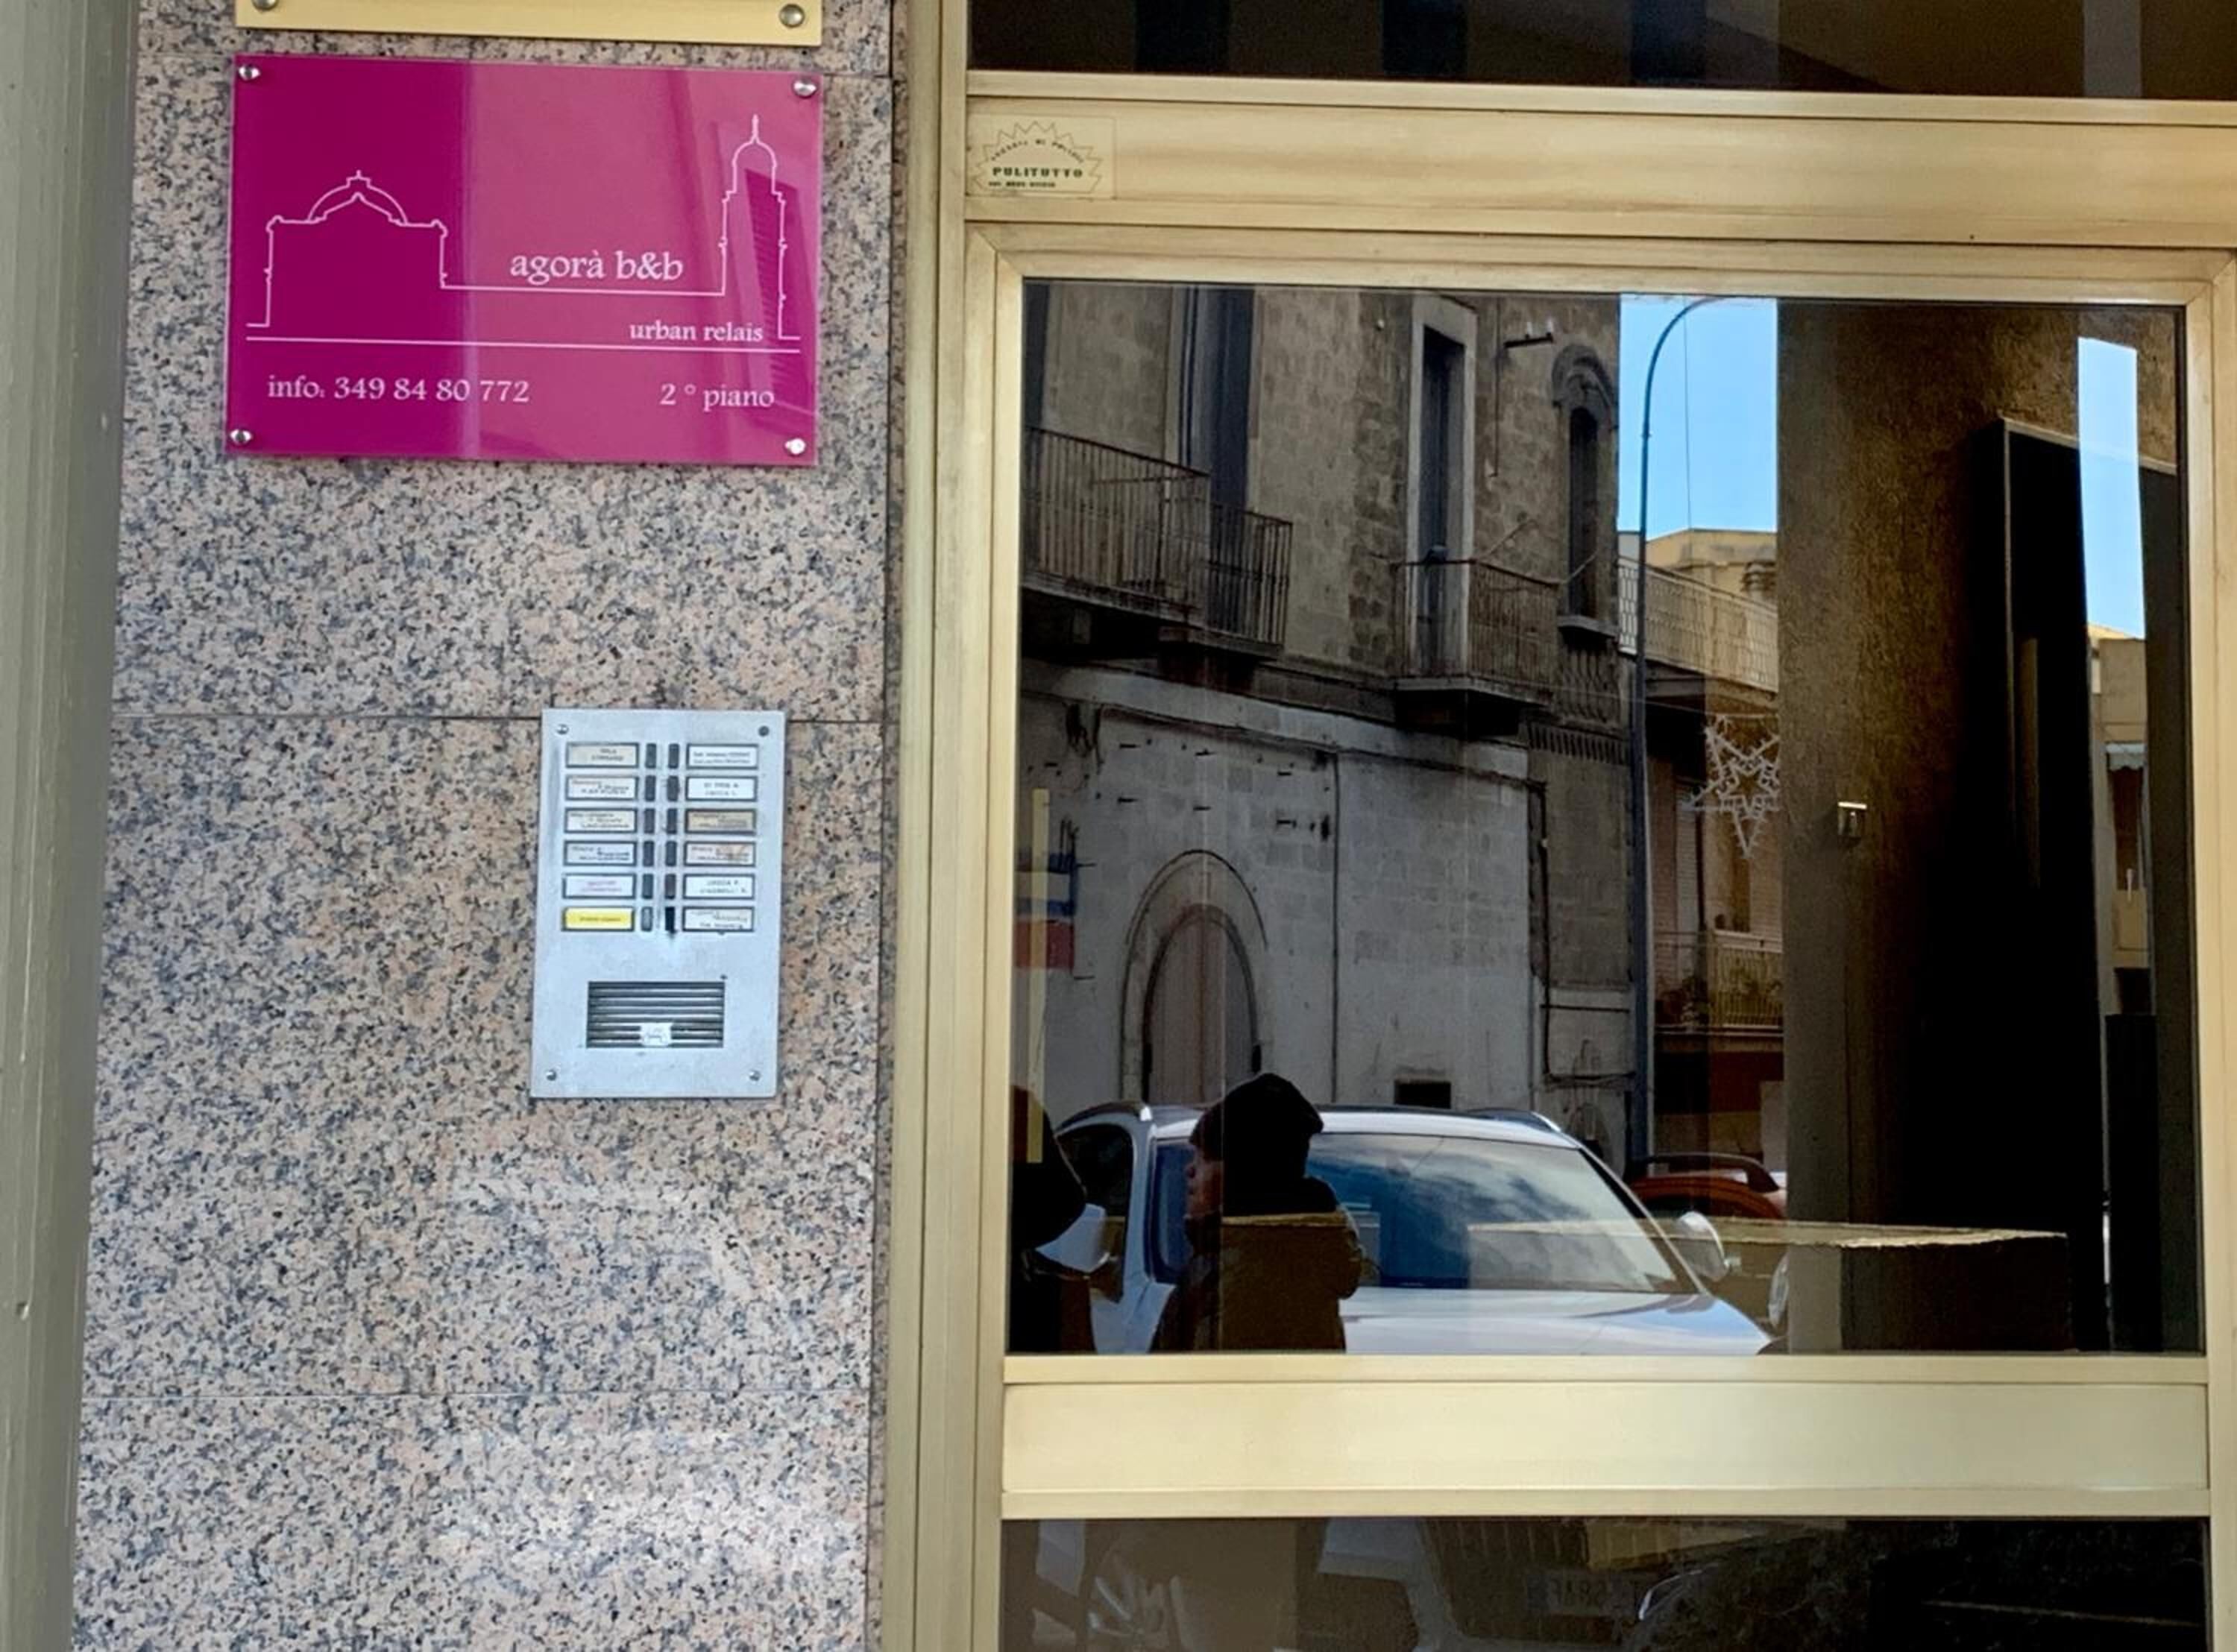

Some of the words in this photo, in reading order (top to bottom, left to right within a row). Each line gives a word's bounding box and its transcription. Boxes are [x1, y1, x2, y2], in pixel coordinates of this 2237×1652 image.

[992, 167, 1083, 177] PULITUTTO
[510, 250, 605, 285] agorà
[614, 250, 685, 281] b&b
[629, 320, 696, 341] urban
[703, 321, 764, 342] relais
[333, 376, 386, 400] 349
[392, 377, 428, 401] 84
[435, 379, 471, 401] 80
[479, 379, 530, 403] 772
[660, 383, 677, 406] 2
[702, 385, 776, 412] piano
